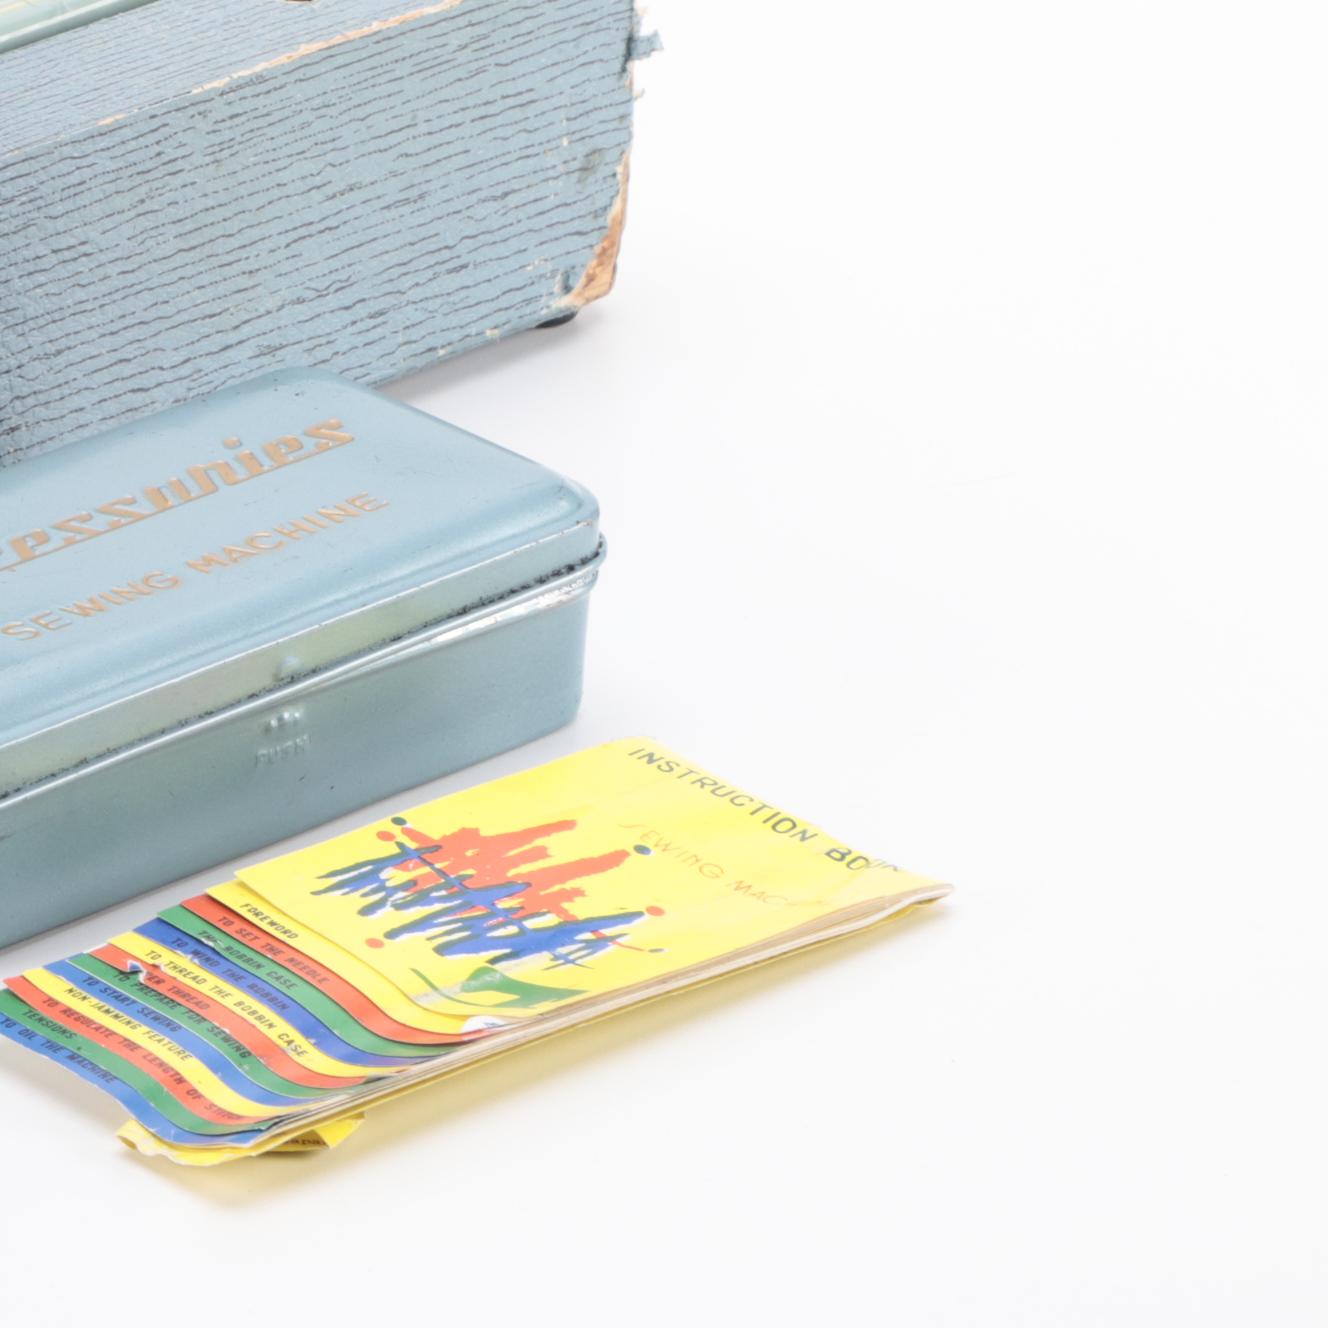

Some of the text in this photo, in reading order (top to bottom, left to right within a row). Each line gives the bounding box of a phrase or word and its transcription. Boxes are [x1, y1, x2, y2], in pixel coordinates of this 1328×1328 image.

[0, 492, 390, 641] SEWING MACHINE
[628, 747, 818, 843] INSTRUCTION
[218, 916, 330, 984] TO SET THE NEEDLE
[240, 903, 299, 939] FOREWORD
[168, 986, 211, 1010] THREAD
[171, 937, 290, 1011] TO WIND THE BOBBIN
[224, 945, 265, 970] BOBBIN
[265, 970, 298, 990] CASE
[22, 1009, 78, 1039] TENSIONS
[64, 987, 193, 1062] NON-JAMMING FEATURE
[82, 976, 182, 1033] TO START SEWING
[145, 950, 309, 1058] TO THREAD THE BOBBIN CASE
[0, 1018, 116, 1084] TO OIL THE MACHINE
[42, 997, 59, 1008] TO
[59, 1007, 117, 1039] REGULATE
[118, 1039, 142, 1052] THE
[142, 1052, 187, 1085] LENGTH
[185, 1087, 204, 1100] OF
[207, 1026, 252, 1059] SEWING
